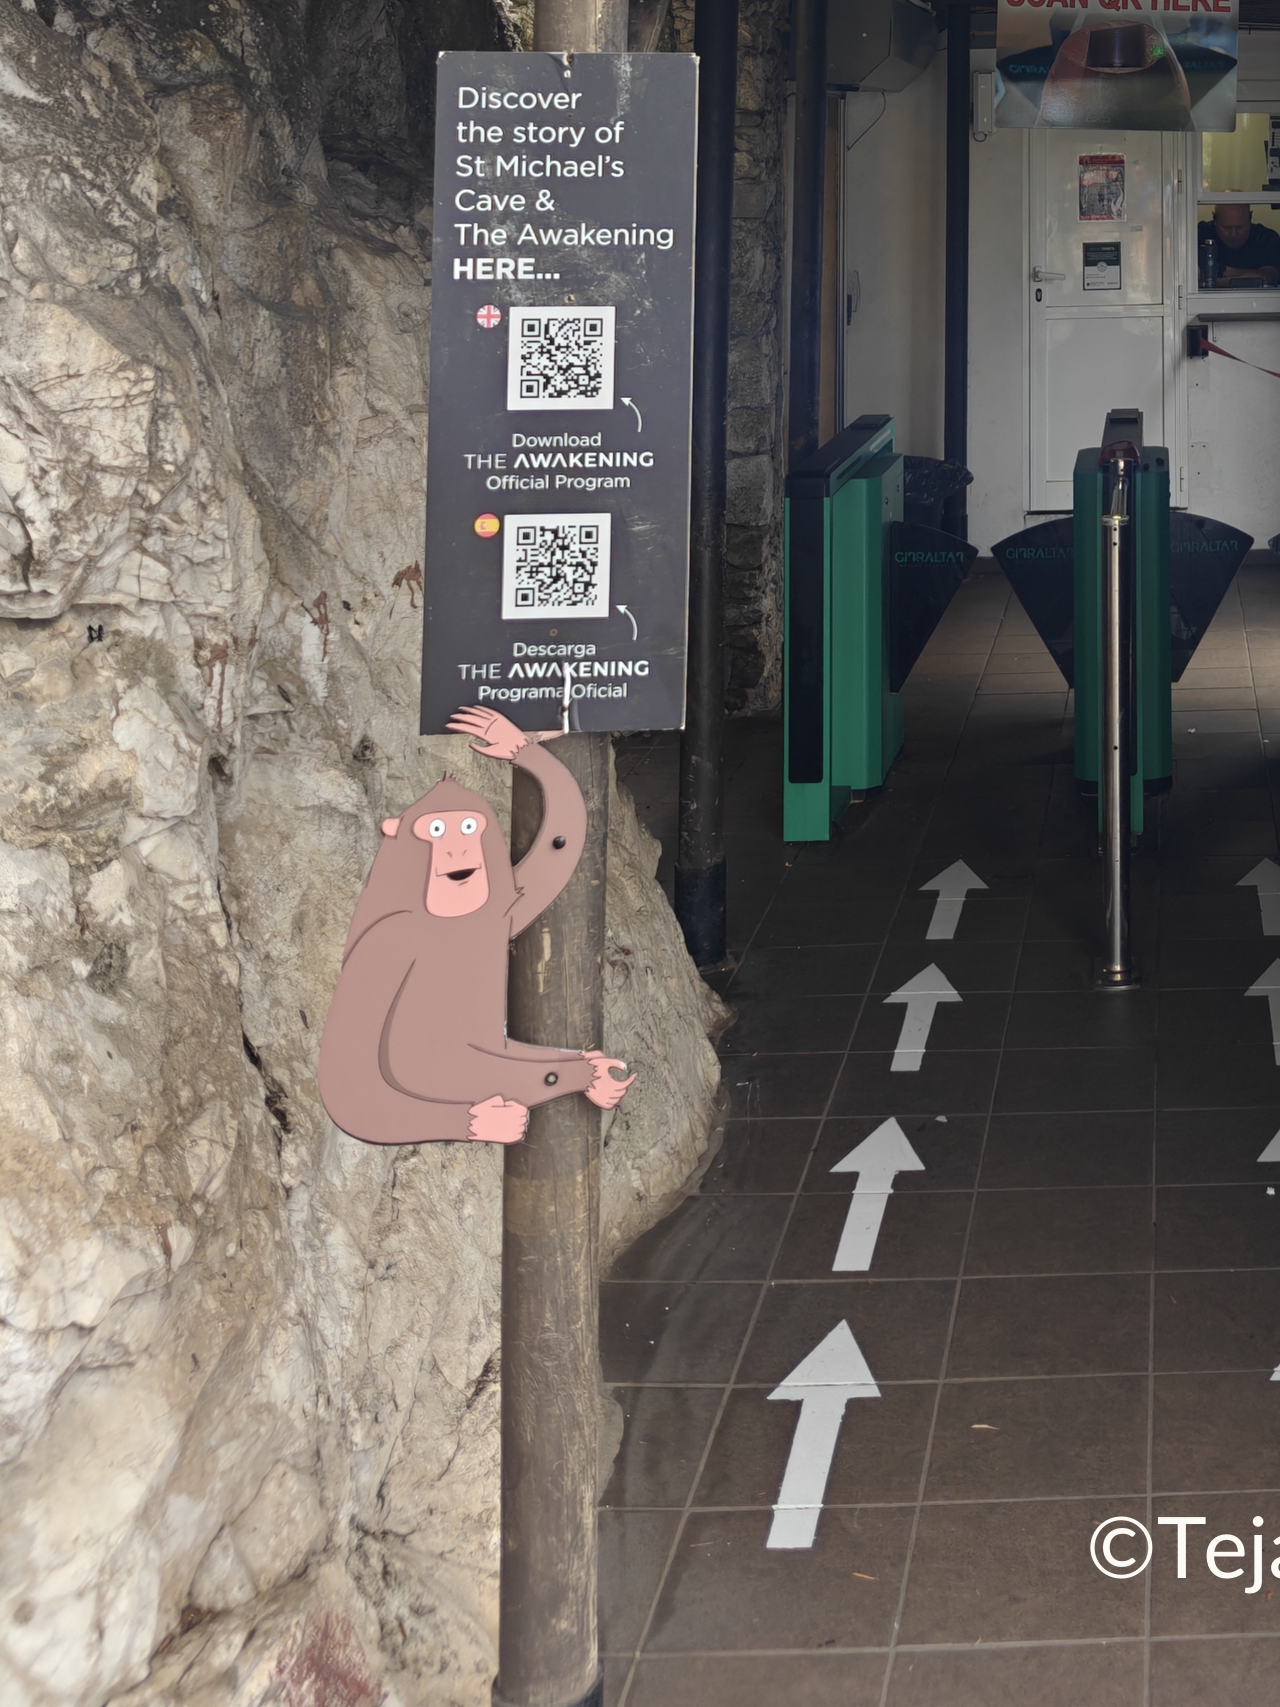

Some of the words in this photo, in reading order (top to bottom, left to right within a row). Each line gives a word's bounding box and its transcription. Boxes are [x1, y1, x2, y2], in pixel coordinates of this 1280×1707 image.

[458, 86, 582, 110] Discover
[456, 121, 503, 143] the
[513, 123, 586, 148] story
[595, 121, 625, 143] of
[455, 155, 485, 177] St
[496, 154, 625, 178] Michael's
[454, 189, 526, 212] Cave
[535, 189, 555, 212] &
[454, 223, 507, 246] The
[516, 223, 674, 250] Awakening
[453, 257, 560, 280] HERE...
[512, 431, 602, 448] Download
[463, 454, 507, 470] THE
[513, 452, 654, 469] AWAKENING
[486, 474, 549, 491] Official
[555, 474, 631, 492] Program
[513, 642, 596, 658] Descarga
[457, 663, 502, 680] THE
[507, 660, 649, 679] AWAKENING
[478, 685, 565, 702] Programa
[572, 682, 628, 699] Oficial
